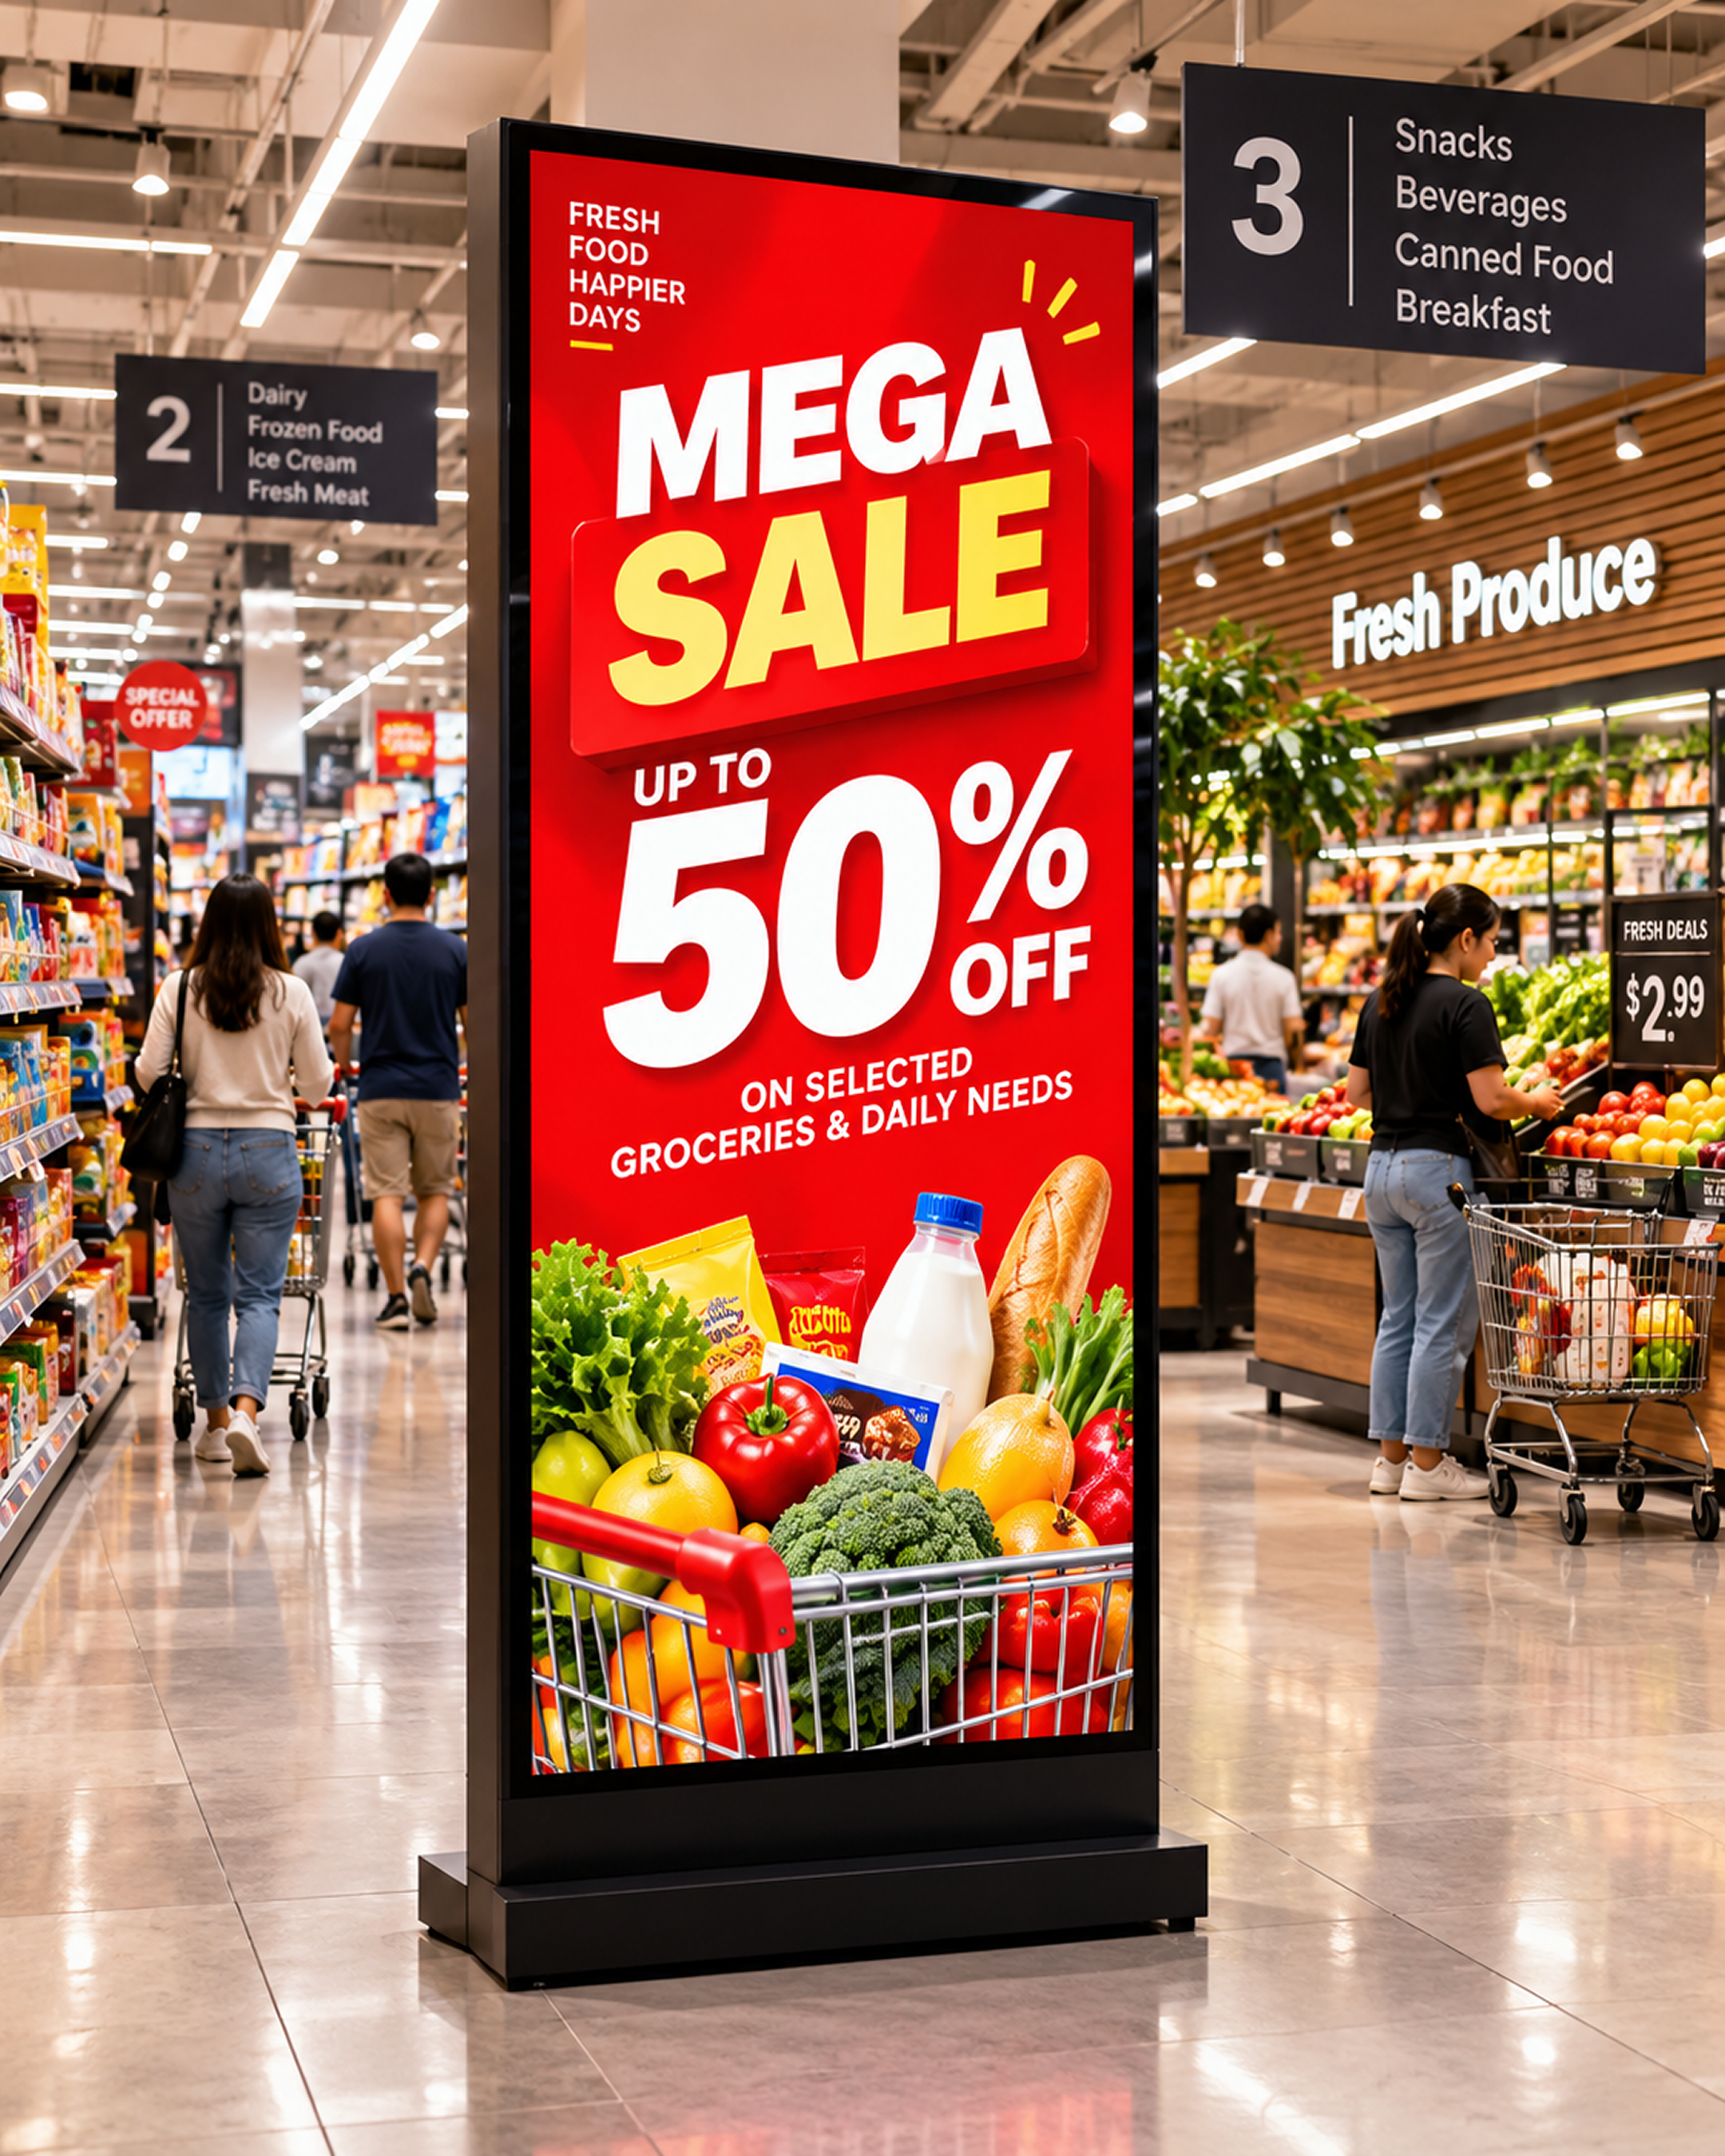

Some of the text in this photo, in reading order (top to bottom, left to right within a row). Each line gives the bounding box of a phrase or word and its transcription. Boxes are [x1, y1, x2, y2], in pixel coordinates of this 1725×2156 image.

[1396, 117, 1513, 161] Snacks
[569, 201, 660, 236] FRESH
[1232, 137, 1303, 256] 3
[1396, 175, 1568, 228] Beverages
[569, 235, 648, 266] FOOD
[1395, 232, 1614, 284] Canned Food
[569, 269, 686, 305] HAPPIER
[569, 302, 641, 333] DAYS
[1396, 288, 1552, 335] Breakfast
[248, 382, 307, 411] Dairy
[146, 396, 191, 462] 2
[248, 415, 383, 444] Frozen Food
[615, 327, 1053, 520] MEGA
[248, 447, 357, 474] Ice Cream
[248, 479, 370, 507] Fresh Meat
[608, 470, 1051, 706] SALE
[1331, 536, 1657, 670] Fresh Produce
[125, 686, 200, 707] SPECIAL
[130, 707, 192, 729] OFFER
[634, 747, 771, 807] UP TO
[603, 750, 1089, 1069] 50%
[1624, 918, 1708, 941] FRESH DEALS
[950, 925, 1092, 1017] OFF
[740, 1047, 974, 1113] ON SELECTED
[611, 1071, 1073, 1179] GROCERIES & DAILY NEEDS
